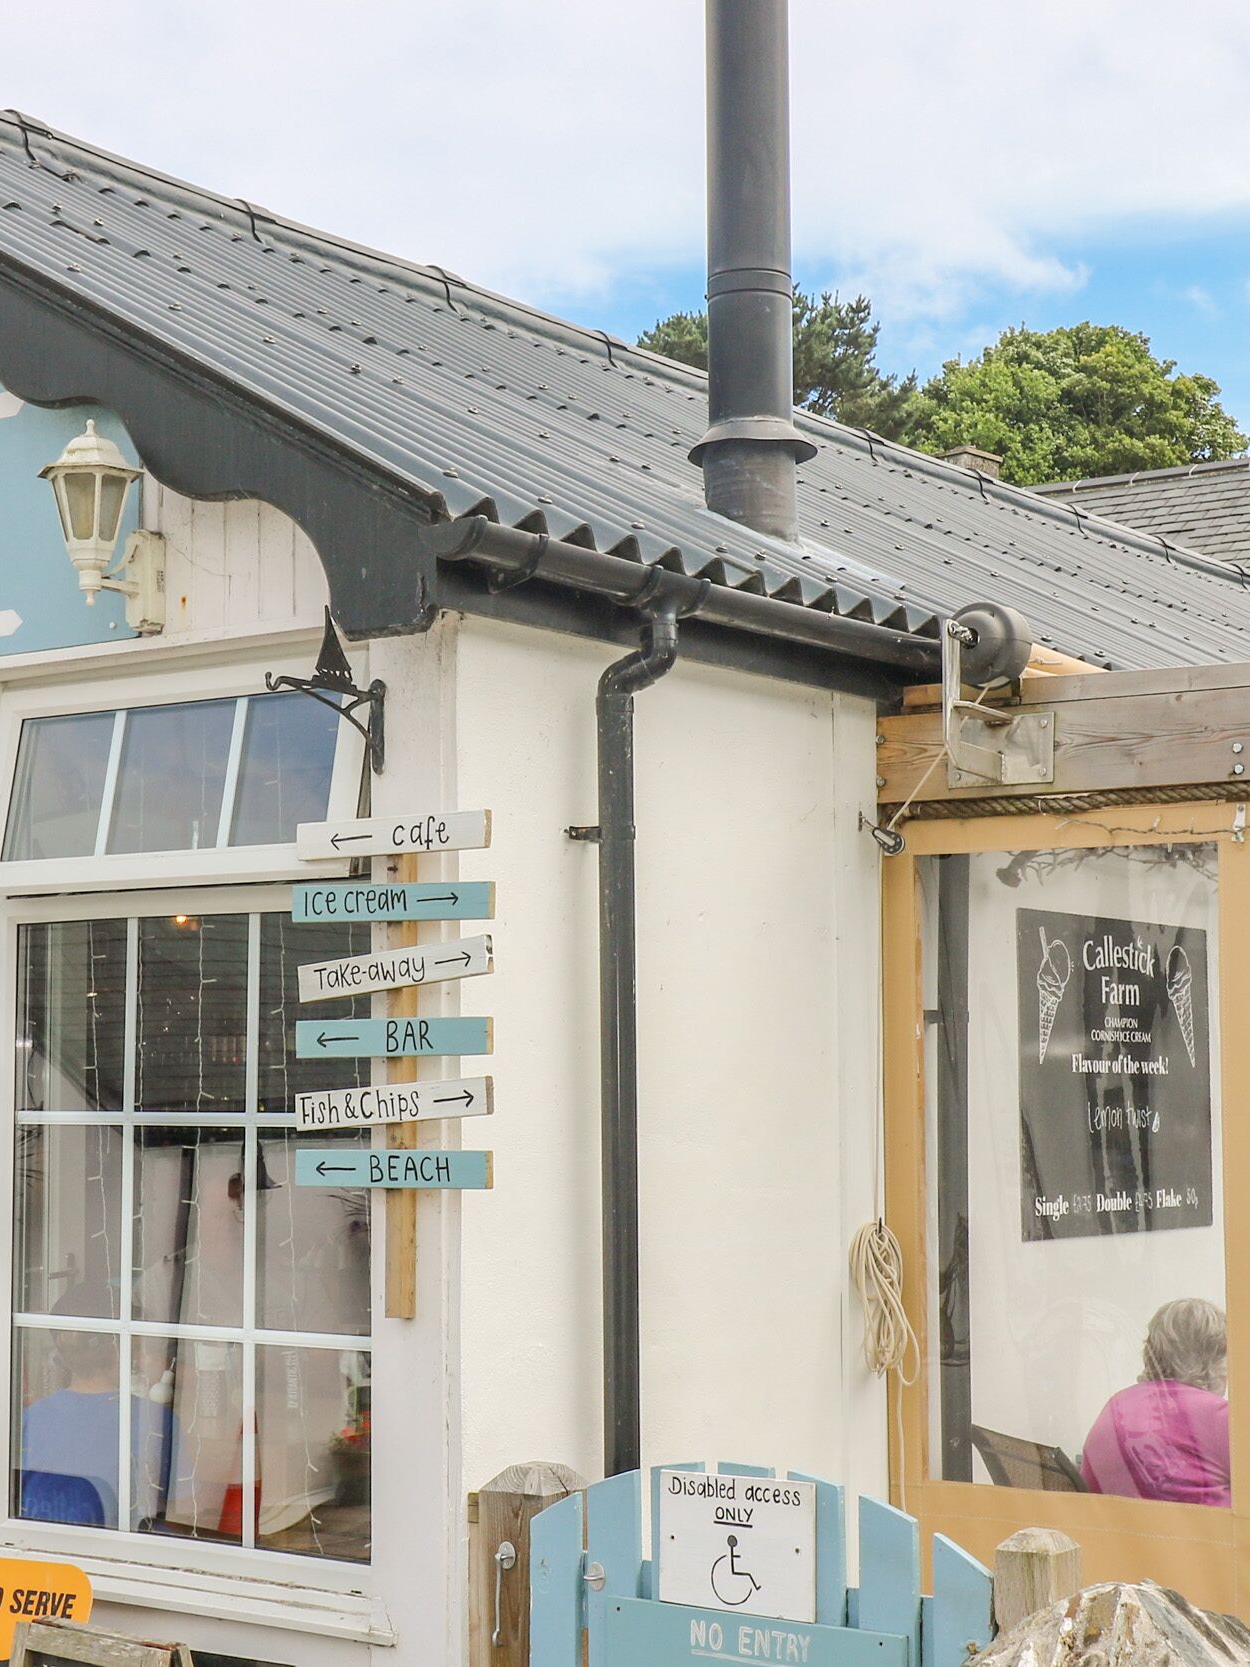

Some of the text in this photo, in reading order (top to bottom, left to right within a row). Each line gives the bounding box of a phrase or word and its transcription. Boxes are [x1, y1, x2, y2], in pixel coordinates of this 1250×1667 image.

[392, 815, 450, 850] cafe
[304, 888, 408, 917] Ice cream
[1082, 935, 1155, 978] Callestick
[313, 955, 426, 991] Take-away
[1101, 975, 1140, 1006] Farm
[385, 1020, 434, 1053] BAR
[1091, 1029, 1152, 1043] CORNISH ICE CREAM
[1104, 1016, 1138, 1029] CHAMPION
[1071, 1053, 1169, 1075] Flavour of the week!
[369, 1154, 451, 1183] BEACH
[1035, 1195, 1070, 1221] Single
[1096, 1190, 1133, 1213] Double
[1156, 1188, 1182, 1209] Flake
[668, 1476, 801, 1507] Disabled access
[714, 1506, 754, 1524] ONLY
[9, 1588, 77, 1619] SERVE
[690, 1618, 812, 1663] NO ENTRY
